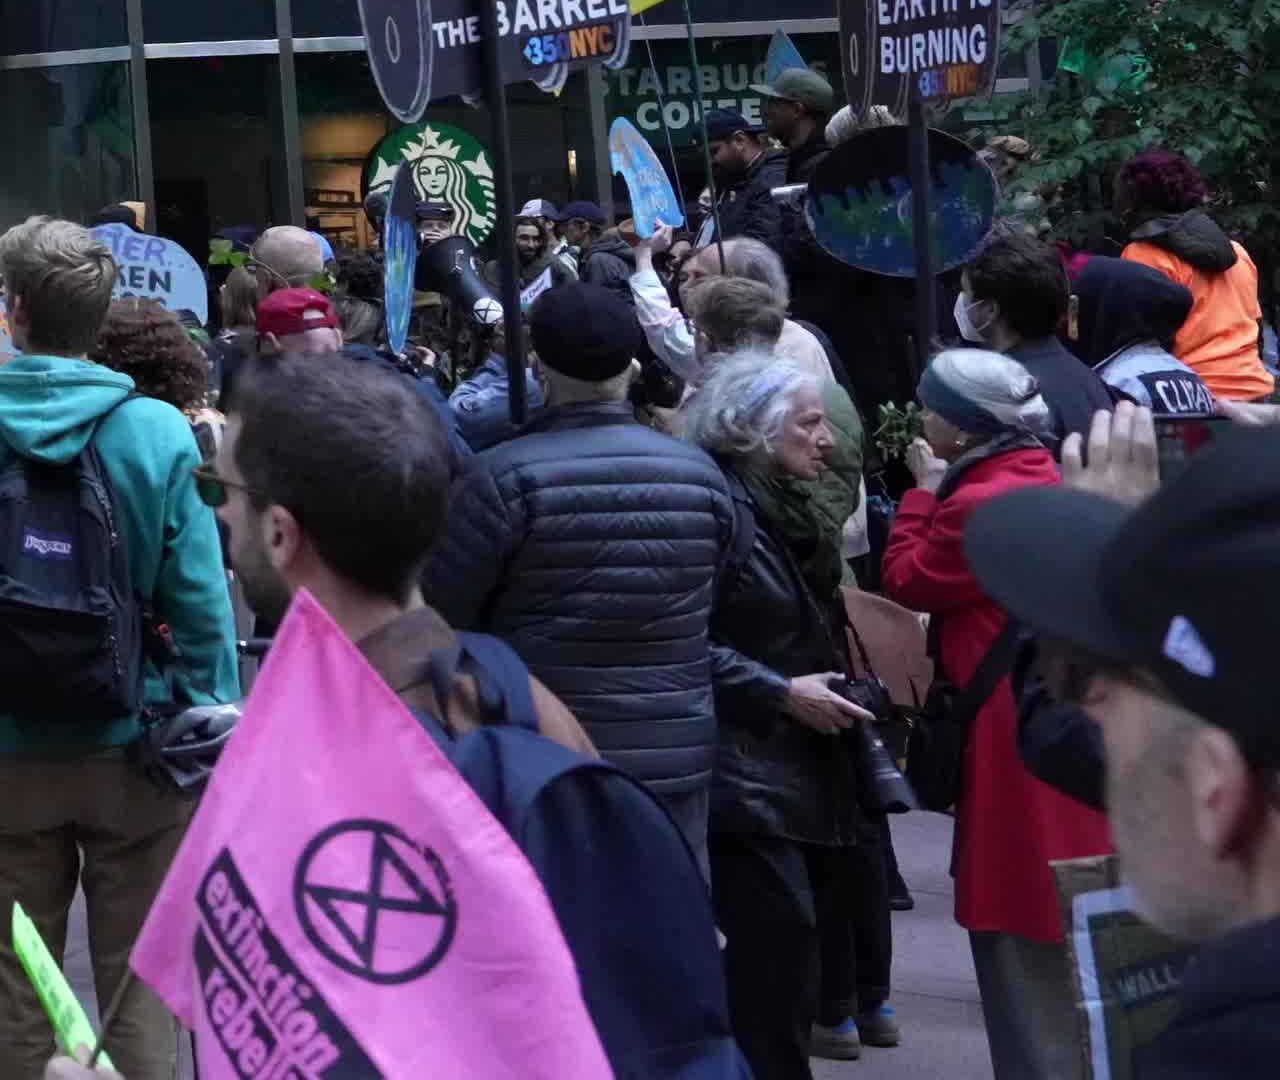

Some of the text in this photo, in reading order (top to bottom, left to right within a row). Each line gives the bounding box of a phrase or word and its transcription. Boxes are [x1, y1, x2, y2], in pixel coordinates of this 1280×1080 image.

[432, 16, 480, 49] THE
[525, 24, 615, 65] 350NYC
[880, 23, 987, 73] BURNING
[205, 869, 341, 1076] extinction
